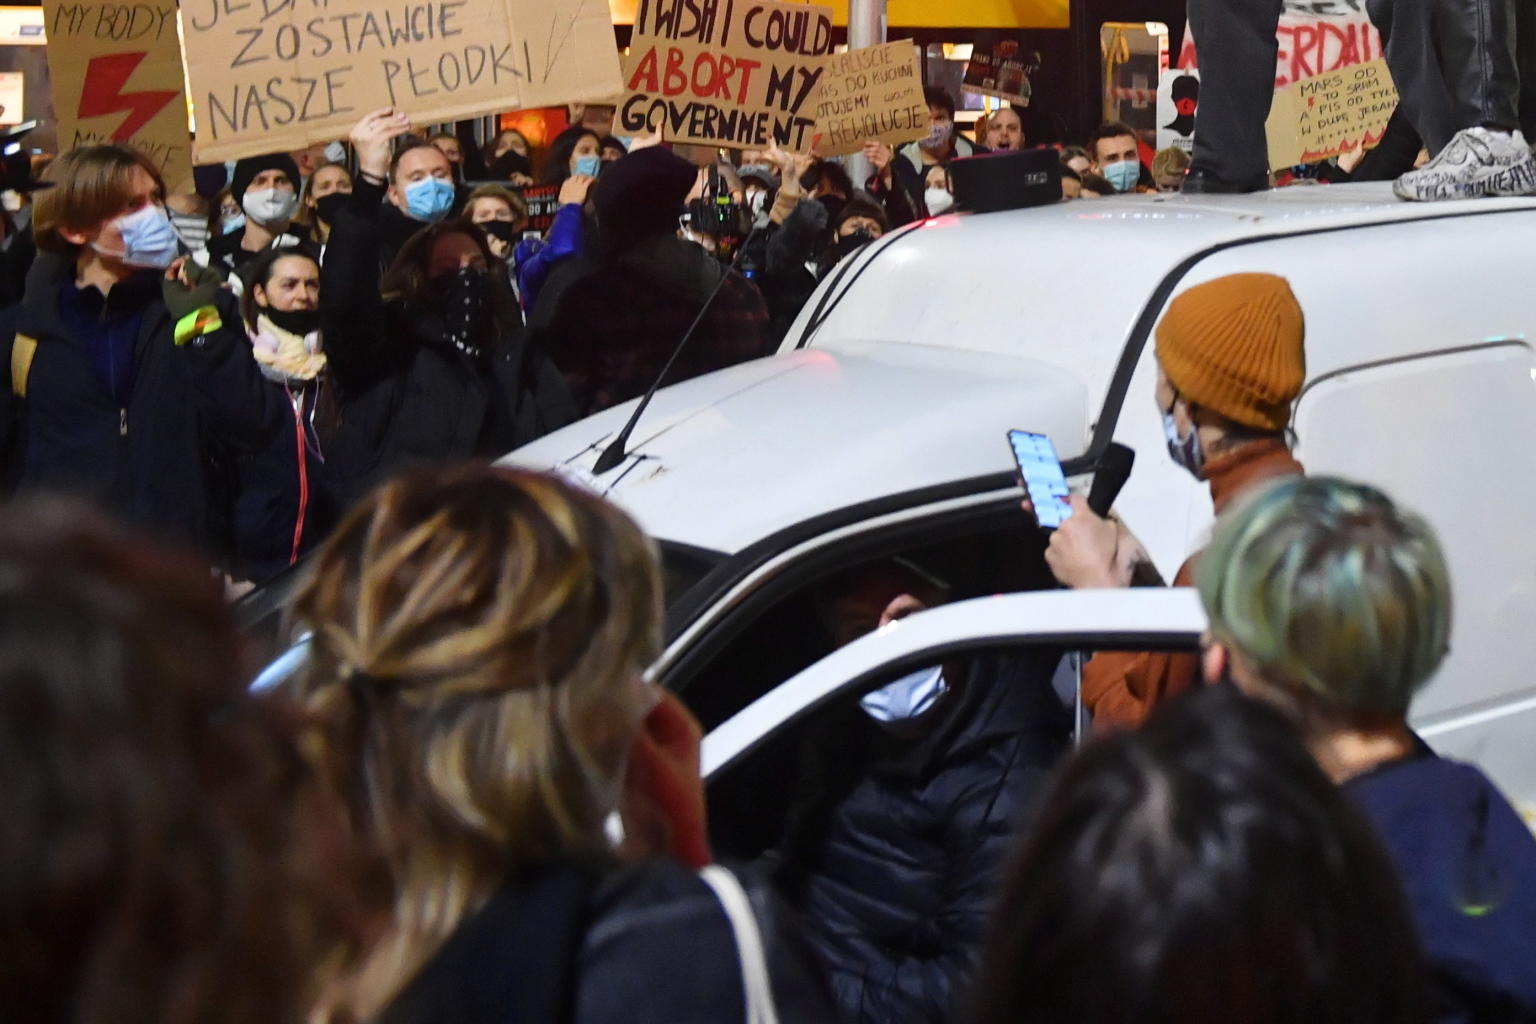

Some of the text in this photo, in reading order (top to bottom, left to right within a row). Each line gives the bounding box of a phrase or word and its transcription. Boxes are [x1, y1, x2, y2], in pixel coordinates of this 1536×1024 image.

[53, 3, 171, 40] MY BODY
[744, 5, 835, 56] COULD
[207, 39, 532, 140] NASZE PŁODKI
[627, 45, 824, 114] ABORT MY
[845, 75, 868, 93] DO
[1323, 91, 1338, 101] TO
[621, 94, 816, 151] GOVERNMENT
[815, 93, 870, 120] OTUJEMY
[1320, 102, 1341, 114] PIS
[1347, 97, 1363, 106] OD
